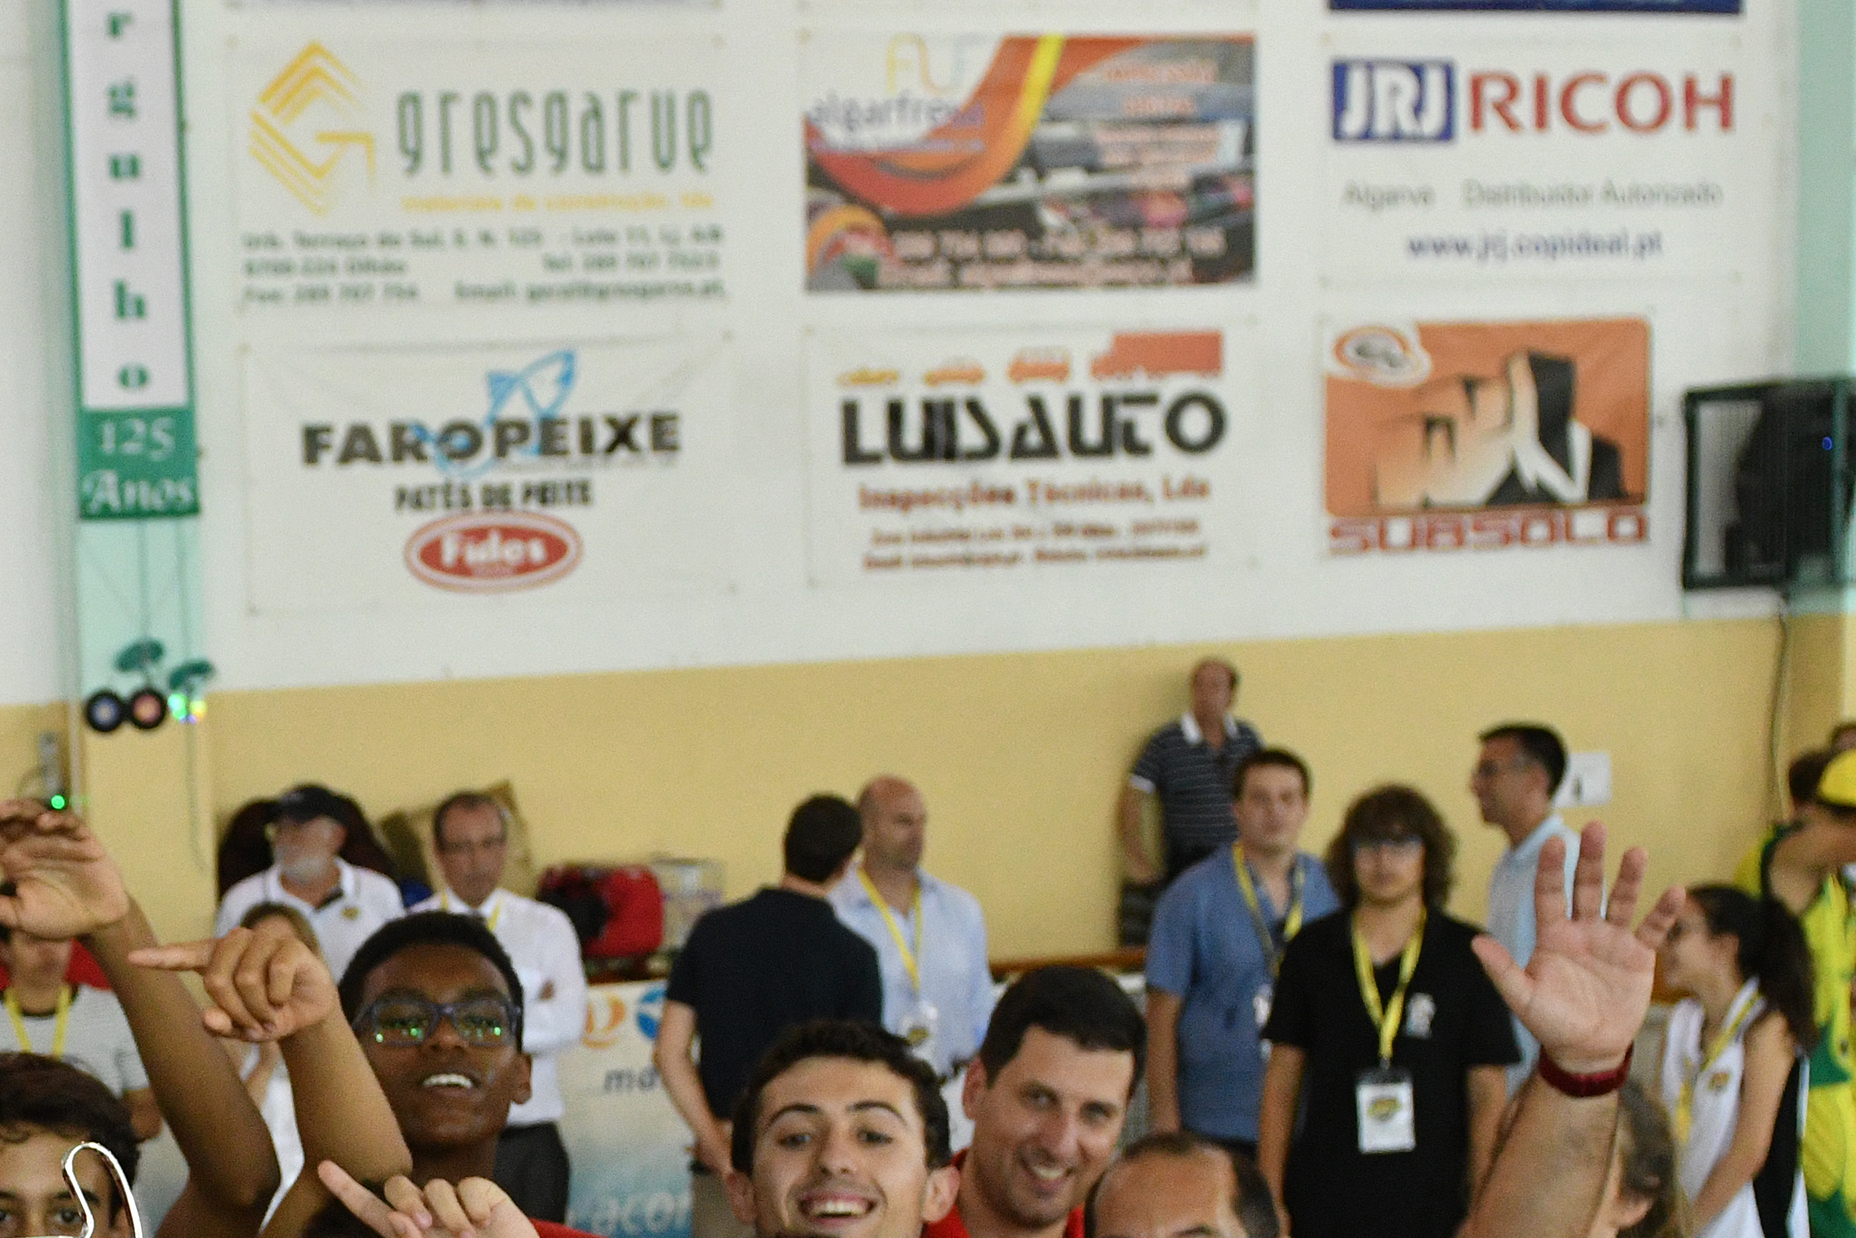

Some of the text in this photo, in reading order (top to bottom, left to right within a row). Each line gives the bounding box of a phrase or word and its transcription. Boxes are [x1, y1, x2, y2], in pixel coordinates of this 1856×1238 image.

[1342, 62, 1734, 137] JRJ RICOH
[1343, 178, 1724, 211] Algarve Distribuidor Autorizado
[100, 417, 175, 461] 125
[300, 411, 682, 466] FAROPEIXE
[841, 391, 1227, 465] LUISAUTO
[84, 468, 196, 515] Anos
[480, 482, 514, 510] DE
